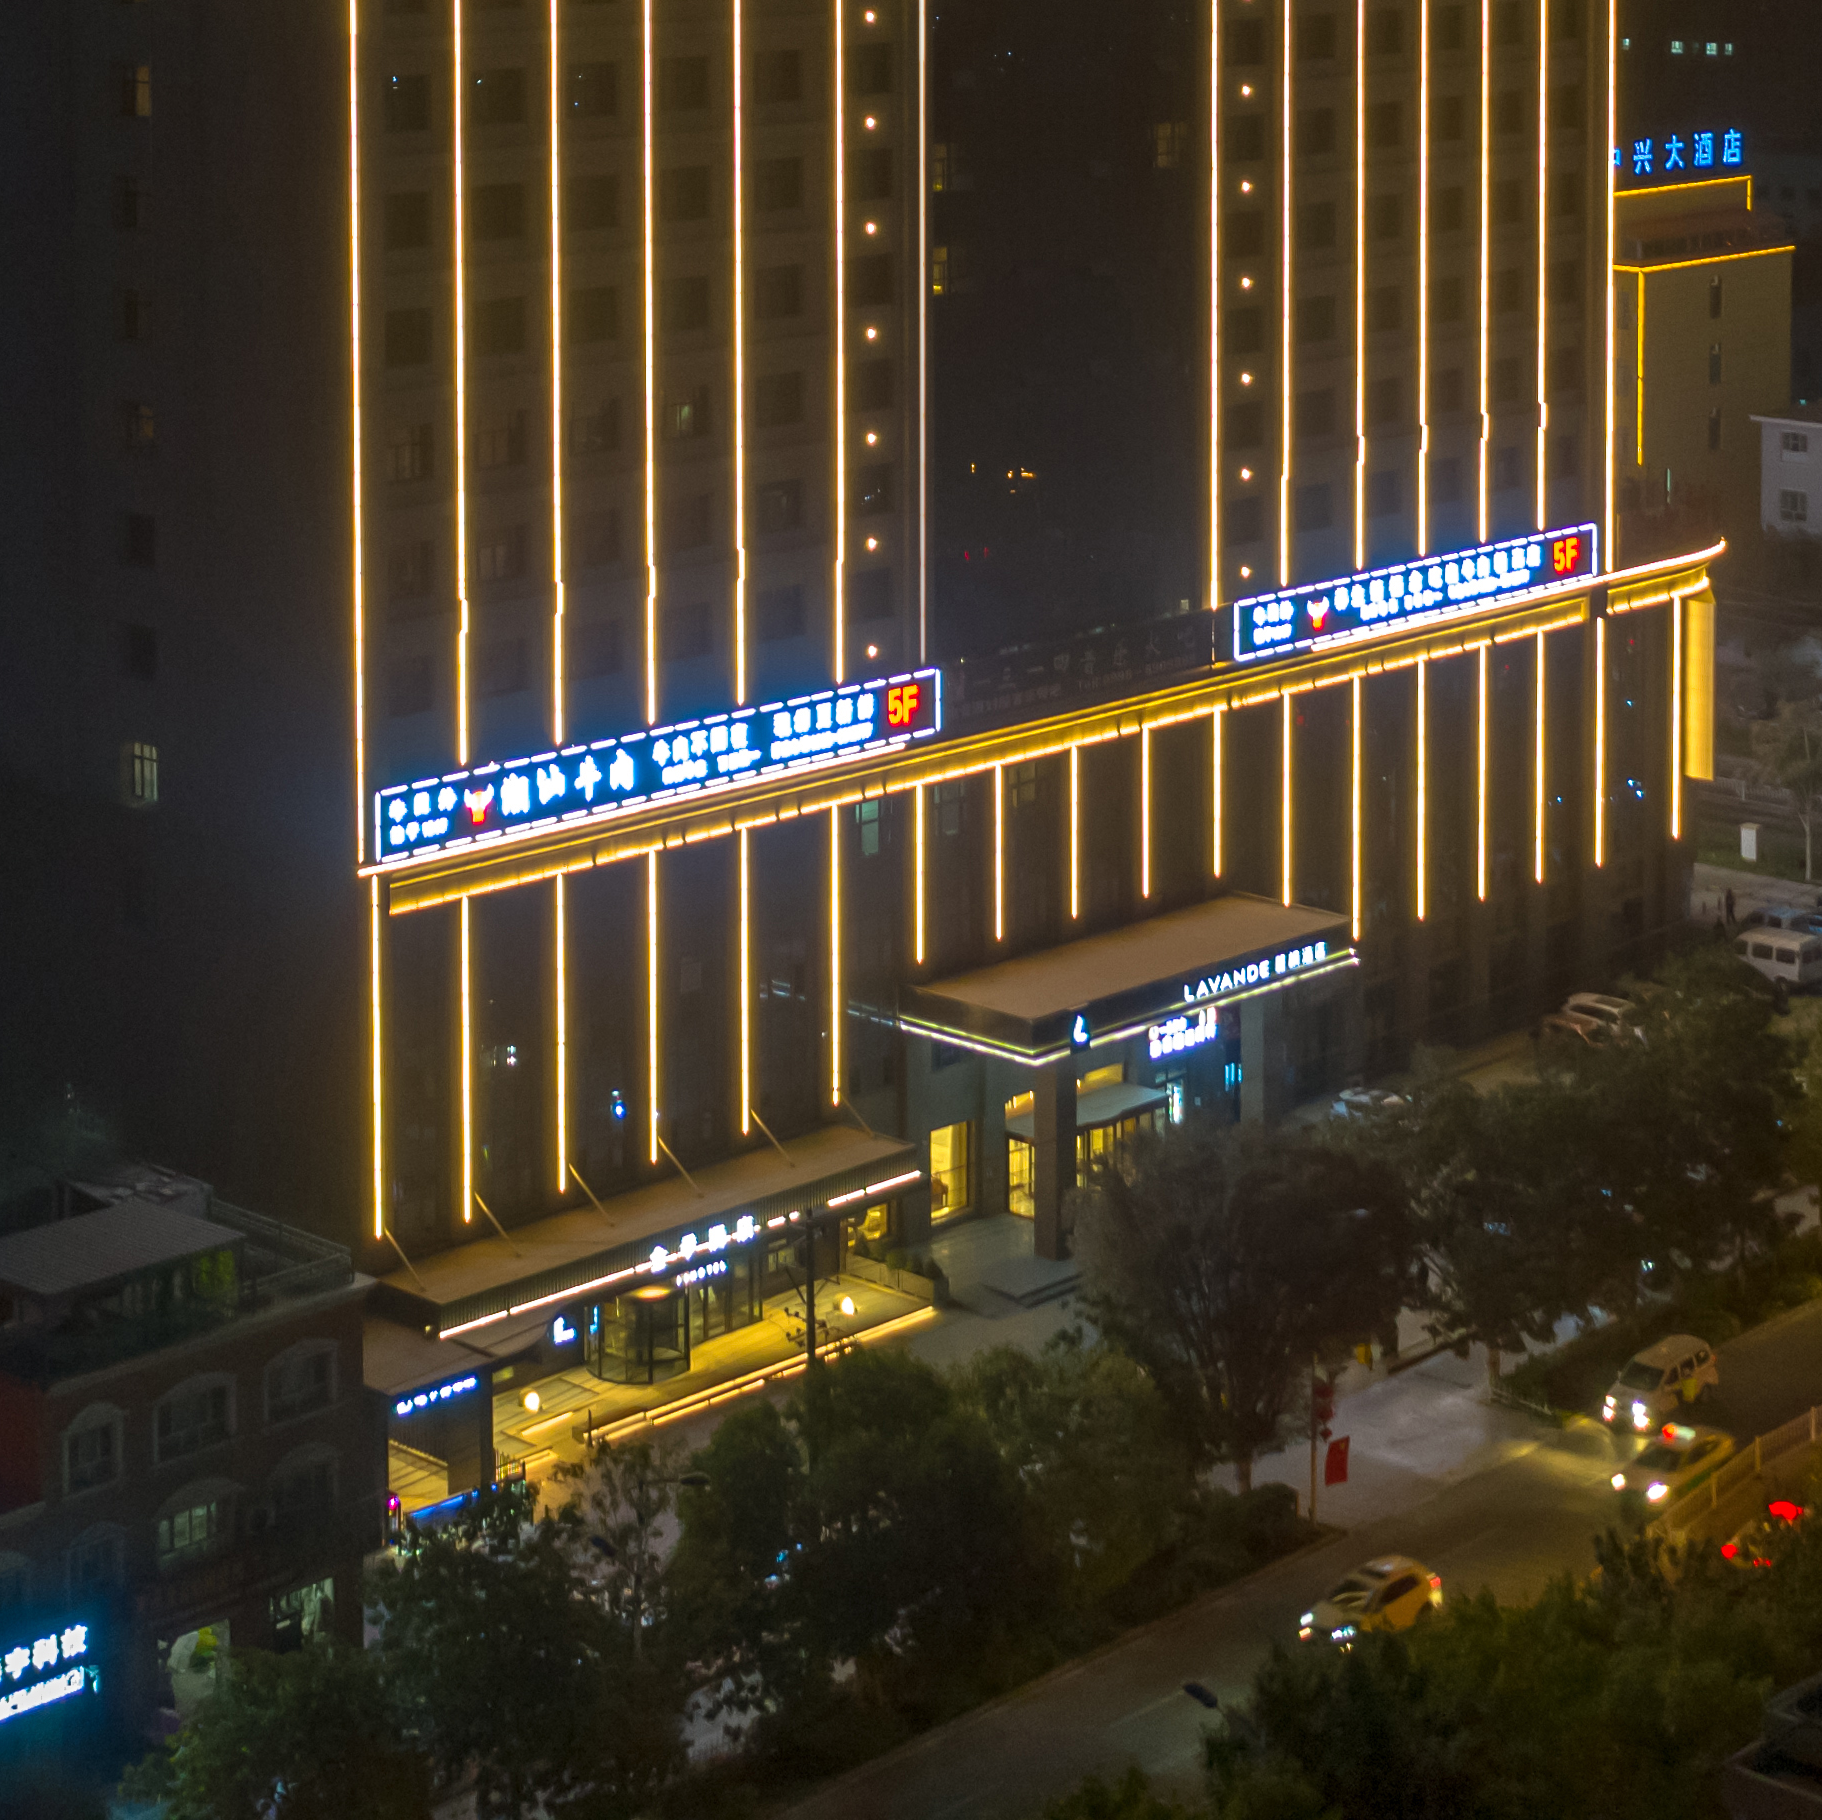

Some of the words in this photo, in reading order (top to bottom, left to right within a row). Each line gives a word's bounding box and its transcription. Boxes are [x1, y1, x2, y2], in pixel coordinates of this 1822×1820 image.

[1552, 536, 1581, 575] 5F
[887, 683, 920, 728] 5F
[1183, 959, 1271, 1003] LAVANDE
